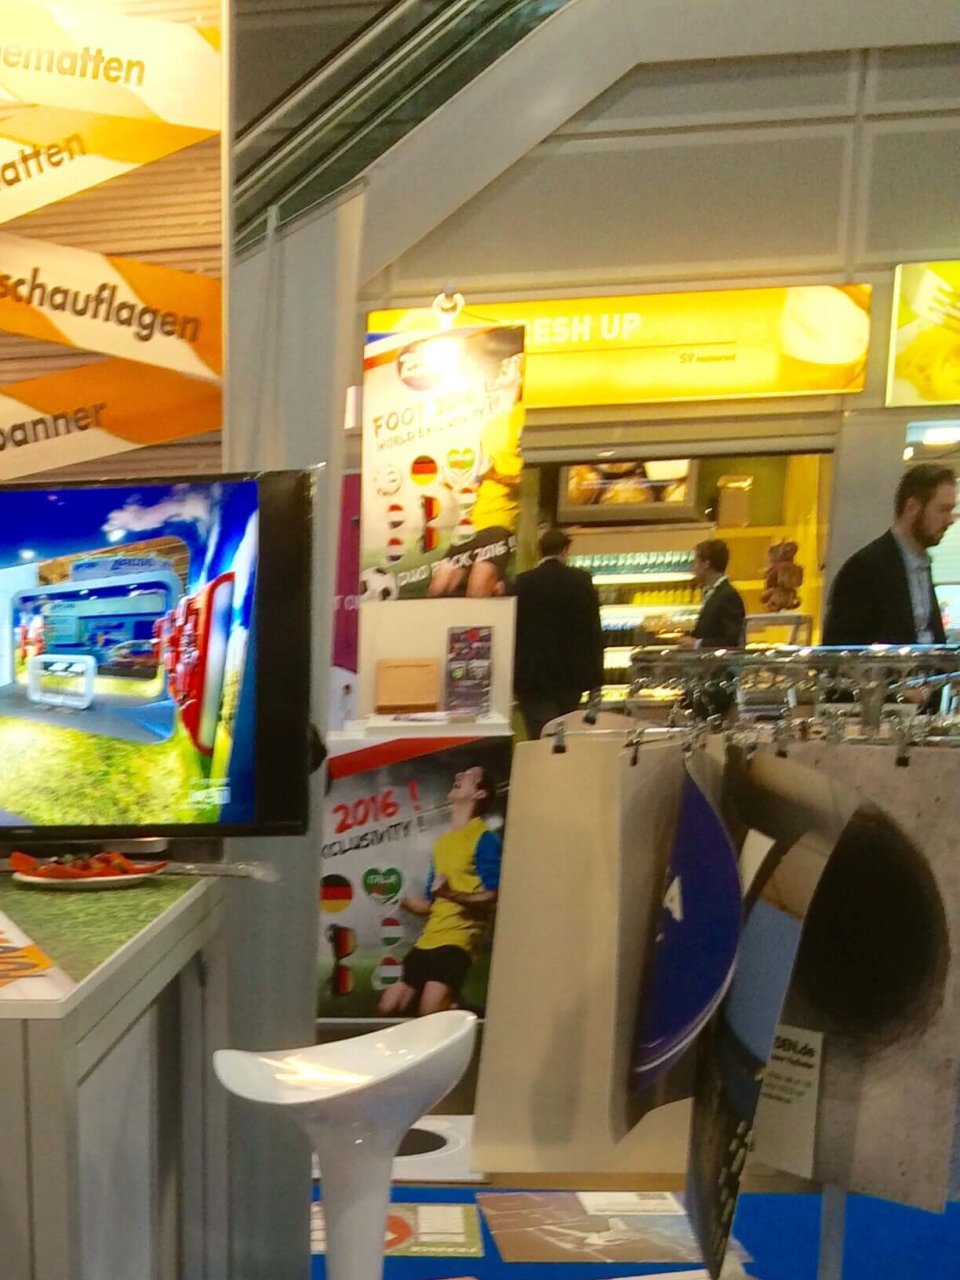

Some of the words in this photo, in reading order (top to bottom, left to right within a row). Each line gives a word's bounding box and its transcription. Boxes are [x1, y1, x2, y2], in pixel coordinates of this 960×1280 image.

[498, 316, 592, 346] RESH
[600, 312, 642, 340] UP
[332, 789, 401, 834] 2016
